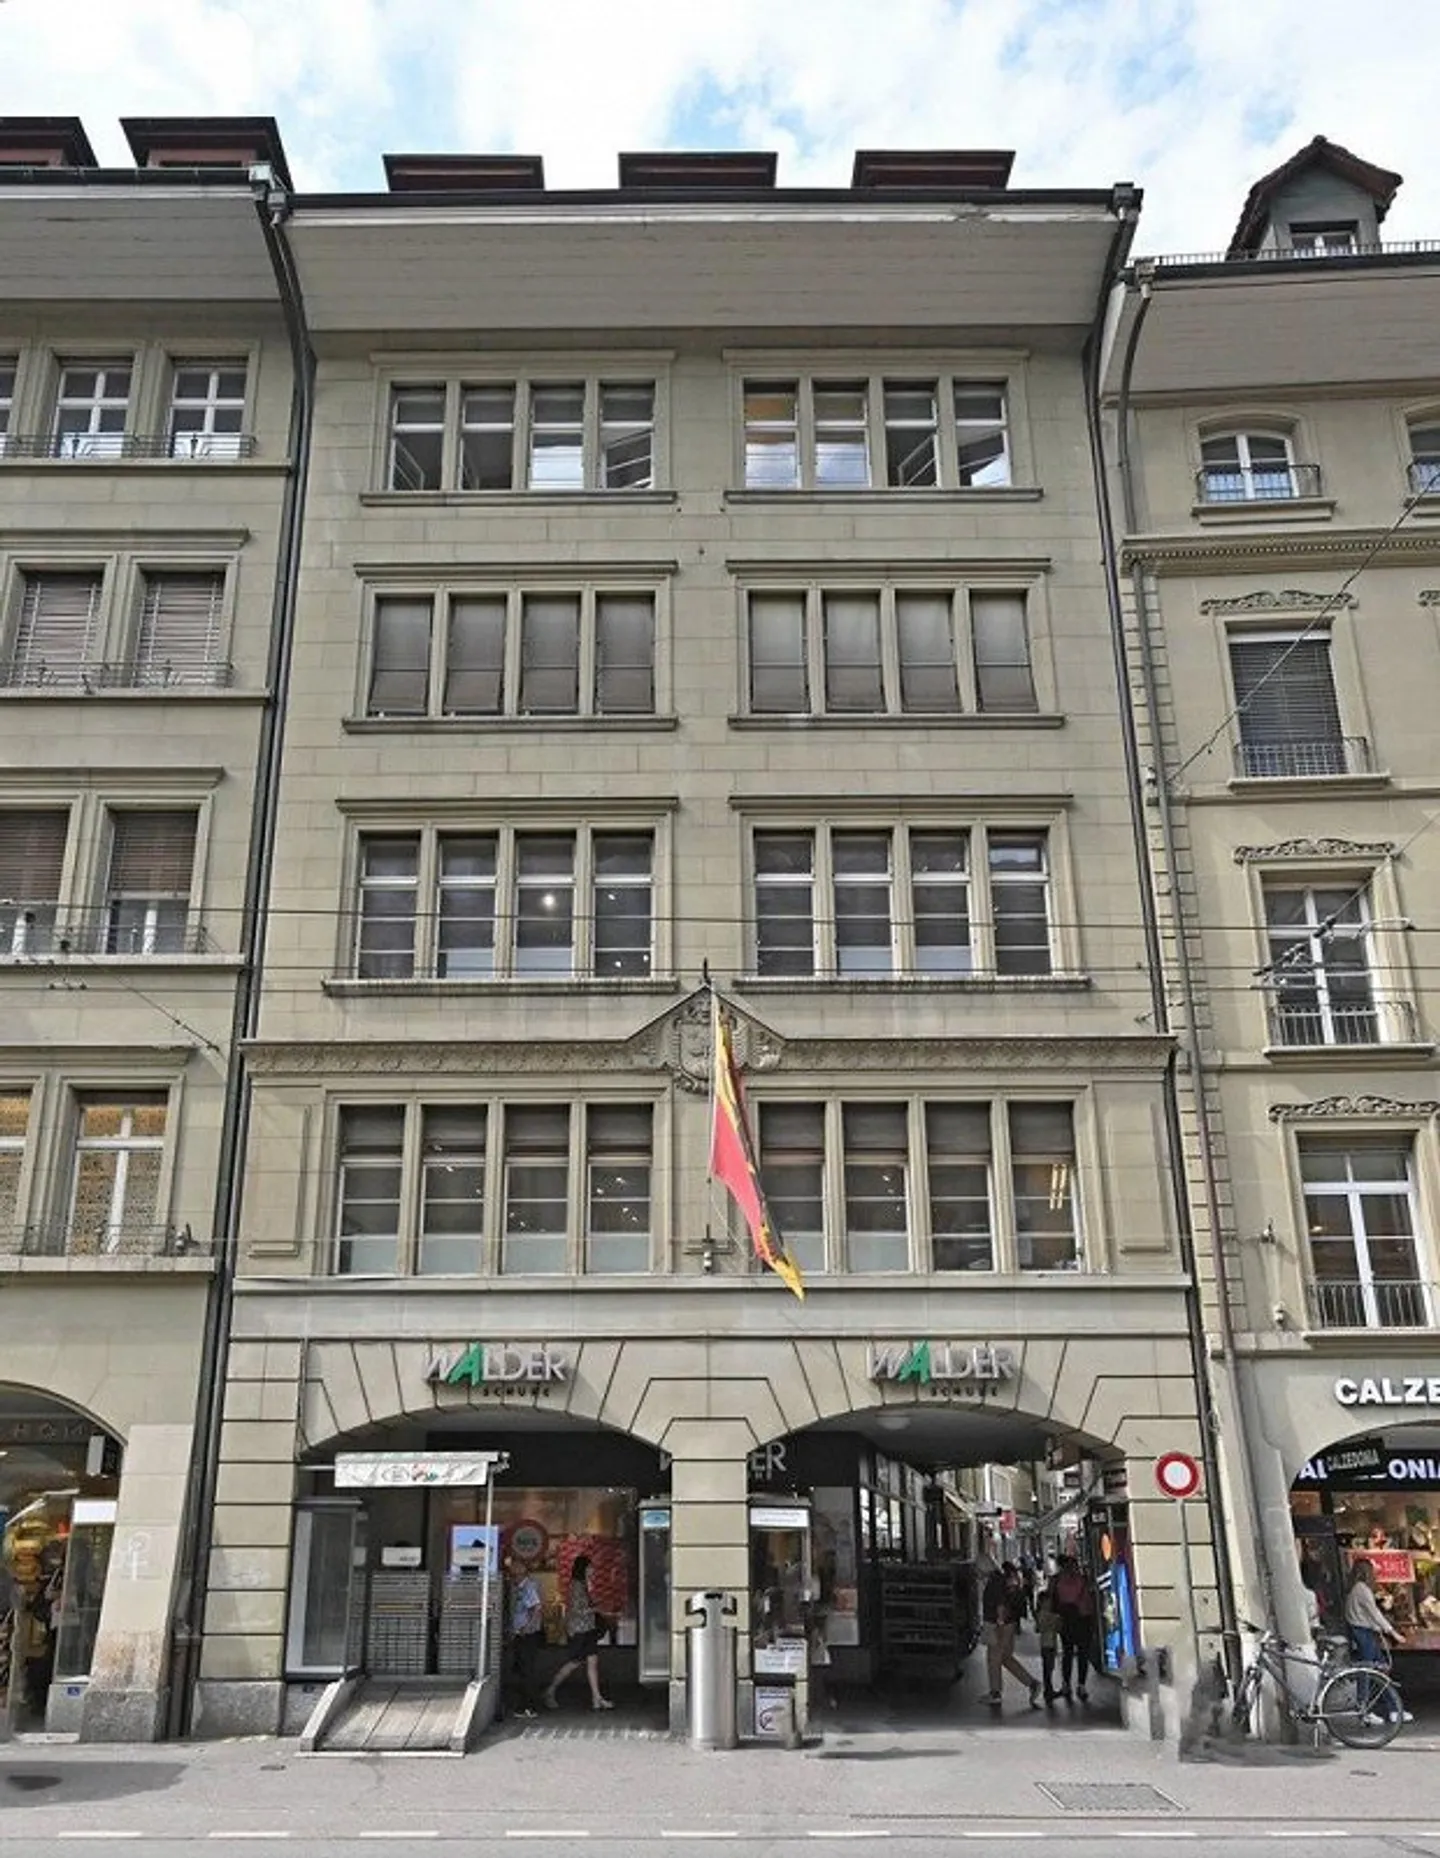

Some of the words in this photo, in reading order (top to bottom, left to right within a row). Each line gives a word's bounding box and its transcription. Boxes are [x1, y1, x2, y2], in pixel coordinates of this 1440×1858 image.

[424, 1342, 567, 1386] WALDER
[866, 1340, 1015, 1384] WALDER
[1335, 1378, 1440, 1404] CALZE
